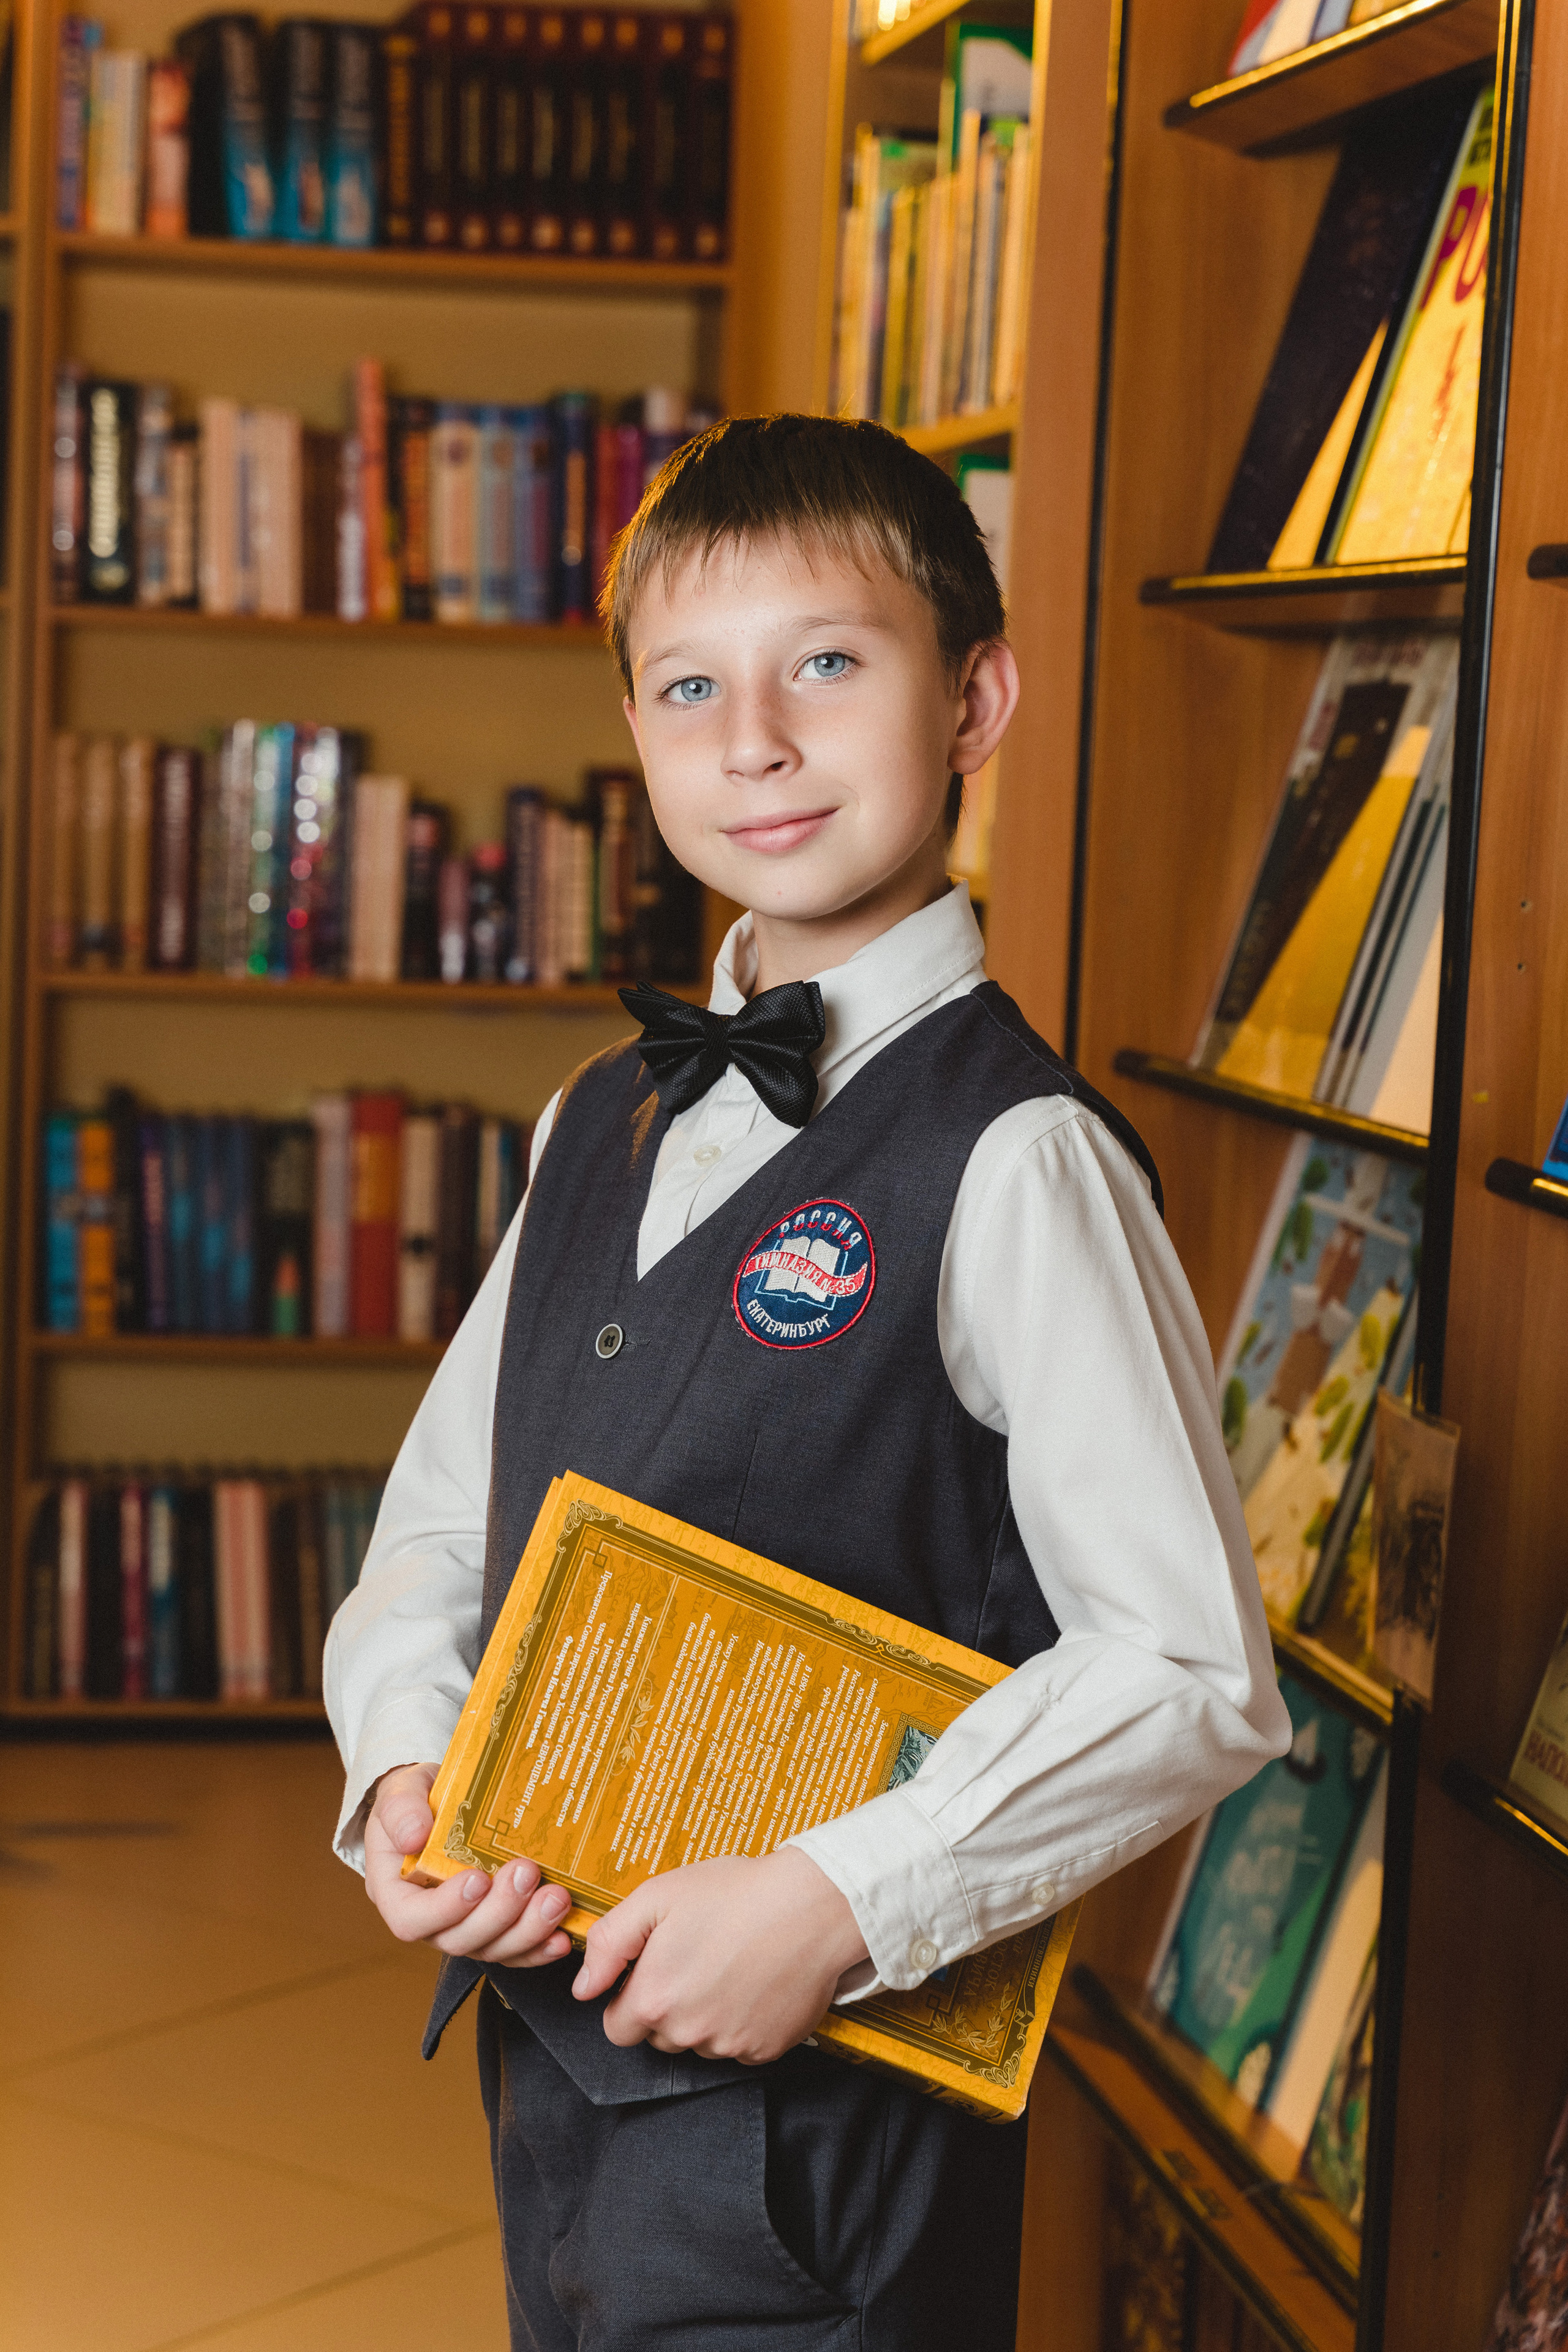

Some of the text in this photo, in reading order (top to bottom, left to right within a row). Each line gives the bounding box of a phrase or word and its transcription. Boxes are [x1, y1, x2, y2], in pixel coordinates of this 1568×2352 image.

[779, 1209, 862, 1251] РОССИЯ
[755, 1252, 822, 1285] ГИМНАЗИЯ
[747, 1298, 831, 1338] ЕКАТЕРИНБУРГ
[586, 1570, 613, 1624] Председателя
[593, 1622, 606, 1645] члена
[624, 1602, 641, 1638] издается
[632, 1615, 652, 1654] Книжная
[684, 1621, 697, 1642] была
[689, 1612, 711, 1662] богатейший
[708, 1628, 716, 1639] по
[576, 1624, 593, 1653] Совета
[620, 1637, 629, 1648] на
[674, 1642, 688, 1669] издана
[597, 1643, 612, 1675] рамках
[607, 1648, 624, 1684] средства
[624, 1653, 636, 1678] серия
[671, 1668, 679, 1680] на
[695, 1639, 712, 1674] истории,
[737, 1639, 765, 1704] Императорского
[758, 1646, 772, 1676] видный
[770, 1644, 784, 1670] автор
[788, 1651, 806, 1686] Николай
[804, 1664, 813, 1673] В
[525, 1635, 574, 1750] Филарета Ильича Гальчева.
[559, 1651, 581, 1700] директоров
[568, 1645, 600, 1715] Попечительского
[584, 1673, 601, 1711] целевого
[764, 1668, 775, 1691] этой
[830, 1664, 850, 1713] развлечения
[844, 1668, 861, 1704] Рассказы
[594, 1683, 614, 1720] Русского
[610, 1678, 629, 1716] «Великие
[654, 1679, 675, 1725] английском,
[664, 1660, 693, 1732] иллюстративный
[679, 1675, 699, 1724] этнографии
[735, 1675, 762, 1742] государственный
[756, 1690, 769, 1714] книги
[767, 1684, 794, 1743] Александрович,
[820, 1686, 831, 1708] среди
[852, 1687, 865, 1714] купцов
[862, 1678, 878, 1716] смотрели
[545, 1699, 566, 1739] Холдинга
[557, 1715, 574, 1743] Совета
[598, 1714, 615, 1749] русские
[726, 1703, 743, 1736] Русского
[783, 1711, 795, 1733] годах
[811, 1708, 824, 1737] такого
[824, 1713, 834, 1728] или
[826, 1709, 846, 1756] зарубежных
[859, 1716, 866, 1727] на
[870, 1706, 881, 1725] книг
[558, 1710, 590, 1781] финансирования
[641, 1725, 658, 1765] немецком
[643, 1640, 723, 1860] способствовал текст, содержавший уникальные сведения
[658, 1728, 669, 1746] ряд.
[665, 1727, 681, 1761] религии
[718, 1644, 797, 1856] большое путешествие на Восток. Сопровождал наследн
[745, 1724, 757, 1746] князь
[779, 1732, 790, 1747] Его
[791, 1711, 812, 1760] высочайших
[804, 1735, 815, 1755] рода
[813, 1727, 829, 1759] отдыха,
[839, 1721, 853, 1749] воинов,
[842, 1726, 862, 1777] окружающий
[863, 1724, 874, 1747] серии
[541, 1744, 564, 1785] Общества,
[570, 1719, 599, 1789] географического
[647, 1633, 739, 1875] Успеху книги, написанной по результатам этого путешествия,
[649, 1747, 664, 1771] Сразу
[681, 1688, 735, 1831] коллекционер буддийских древностей.
[704, 1736, 729, 1799] географического
[723, 1741, 742, 1774] деятель,
[736, 1746, 751, 1770] Эспер
[756, 1744, 774, 1779] будущий
[786, 1759, 796, 1779] особ
[798, 1755, 809, 1774] книг
[816, 1755, 831, 1785] вояжах,
[851, 1719, 889, 1811] Замечательное отличи
[521, 1740, 550, 1806] «ЕВРОЦЕМЕНТ
[572, 1747, 603, 1824] путешественники»
[643, 1770, 655, 1793] после
[655, 1760, 669, 1793] народов
[712, 1774, 728, 1806] ученый,
[723, 1768, 743, 1810] Эсперович
[759, 1746, 783, 1807] императорское
[801, 1760, 818, 1801] появились
[824, 1749, 844, 1796] паломников
[835, 1776, 846, 1794] мир
[844, 1763, 862, 1804] изменении
[556, 1788, 575, 1827] общества
[620, 1770, 644, 1823] французском
[632, 1792, 647, 1822] выхода
[641, 1792, 660, 1828] Востока,
[740, 1778, 761, 1823] император
[774, 1788, 786, 1812] царей
[784, 1773, 802, 1815] занимают
[513, 1804, 526, 1828] груп»
[689, 1798, 708, 1839] общества,
[743, 1806, 763, 1853] высочество
[788, 1800, 805, 1838] значител
[814, 1802, 826, 1826] мисси
[609, 1822, 625, 1852] языках.
[623, 1827, 634, 1849] свет
[707, 1809, 729, 1855] Ухтомский
[755, 1818, 776, 1858] императо
[614, 1847, 628, 1872] книга
[629, 1836, 644, 1864] также
[984, 1937, 1011, 1991] ОСТОК
